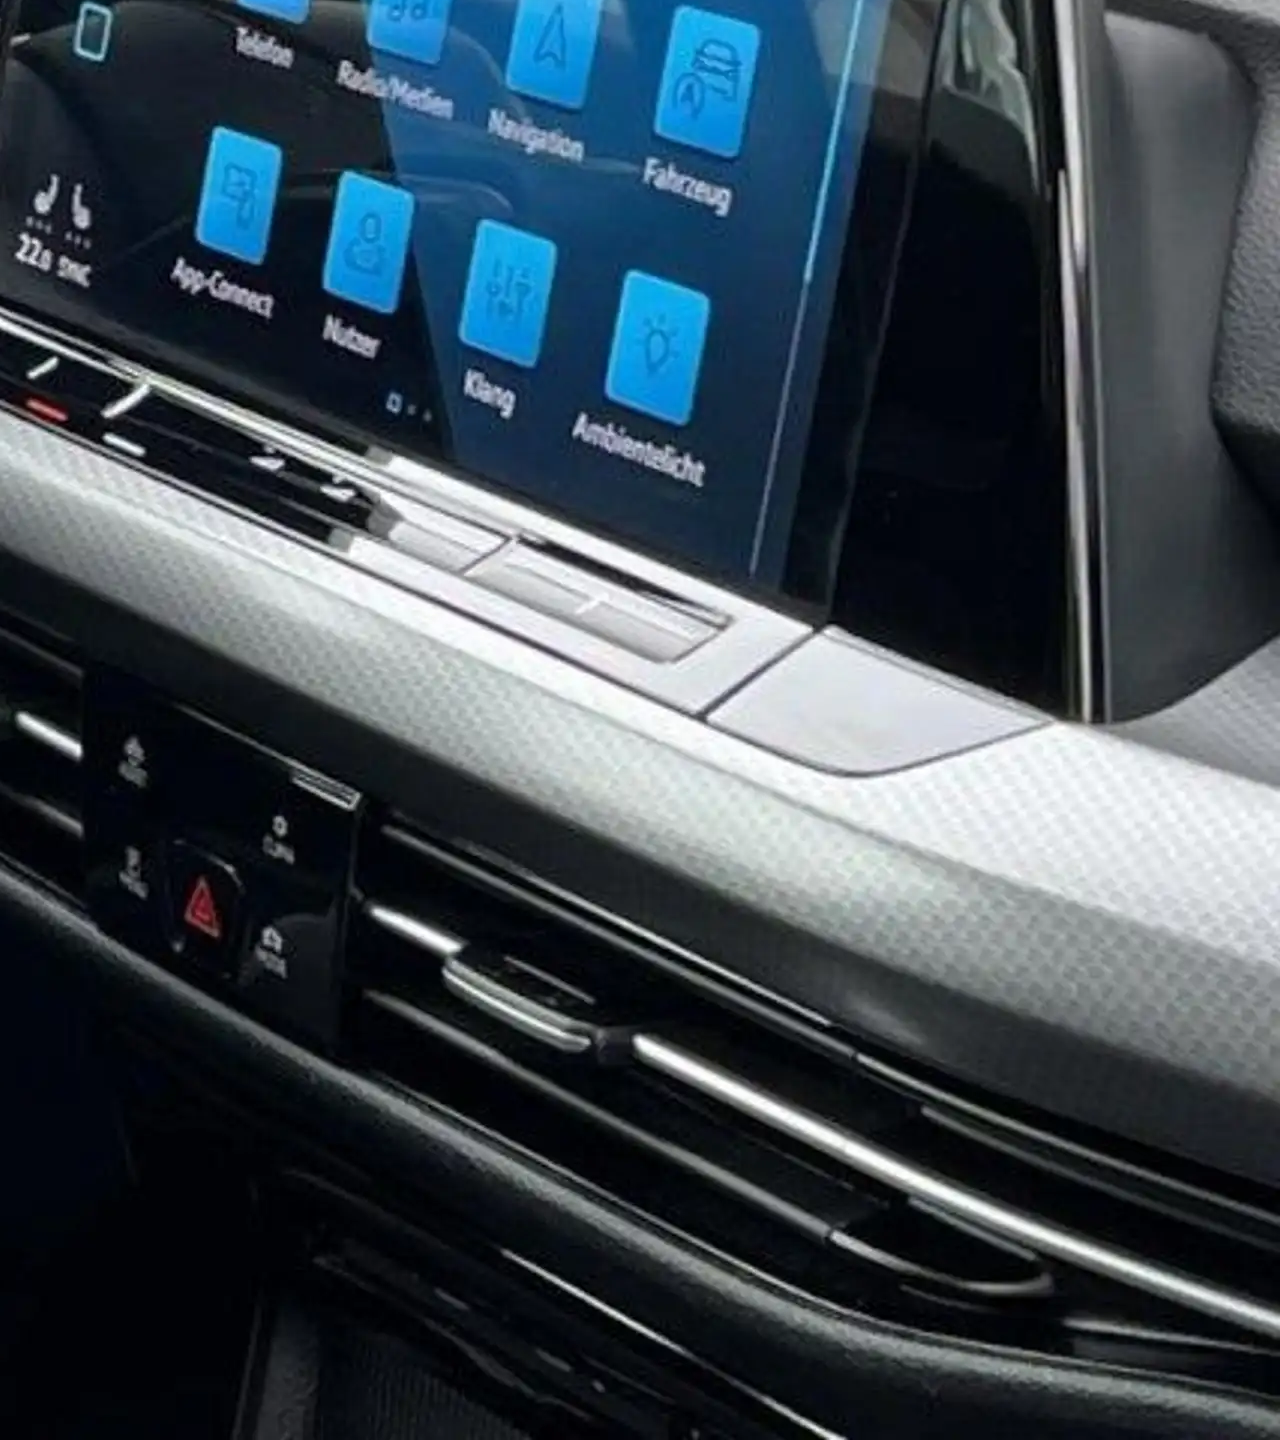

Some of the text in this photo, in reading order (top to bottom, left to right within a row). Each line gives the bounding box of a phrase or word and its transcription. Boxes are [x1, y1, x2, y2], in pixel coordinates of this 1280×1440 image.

[236, 26, 294, 69] Telefon
[487, 108, 585, 161] Navigation
[643, 156, 732, 217] Fahrzeug
[170, 256, 275, 320] App-Connect
[463, 367, 516, 420] Klang
[572, 411, 706, 488] Ambientelicht
